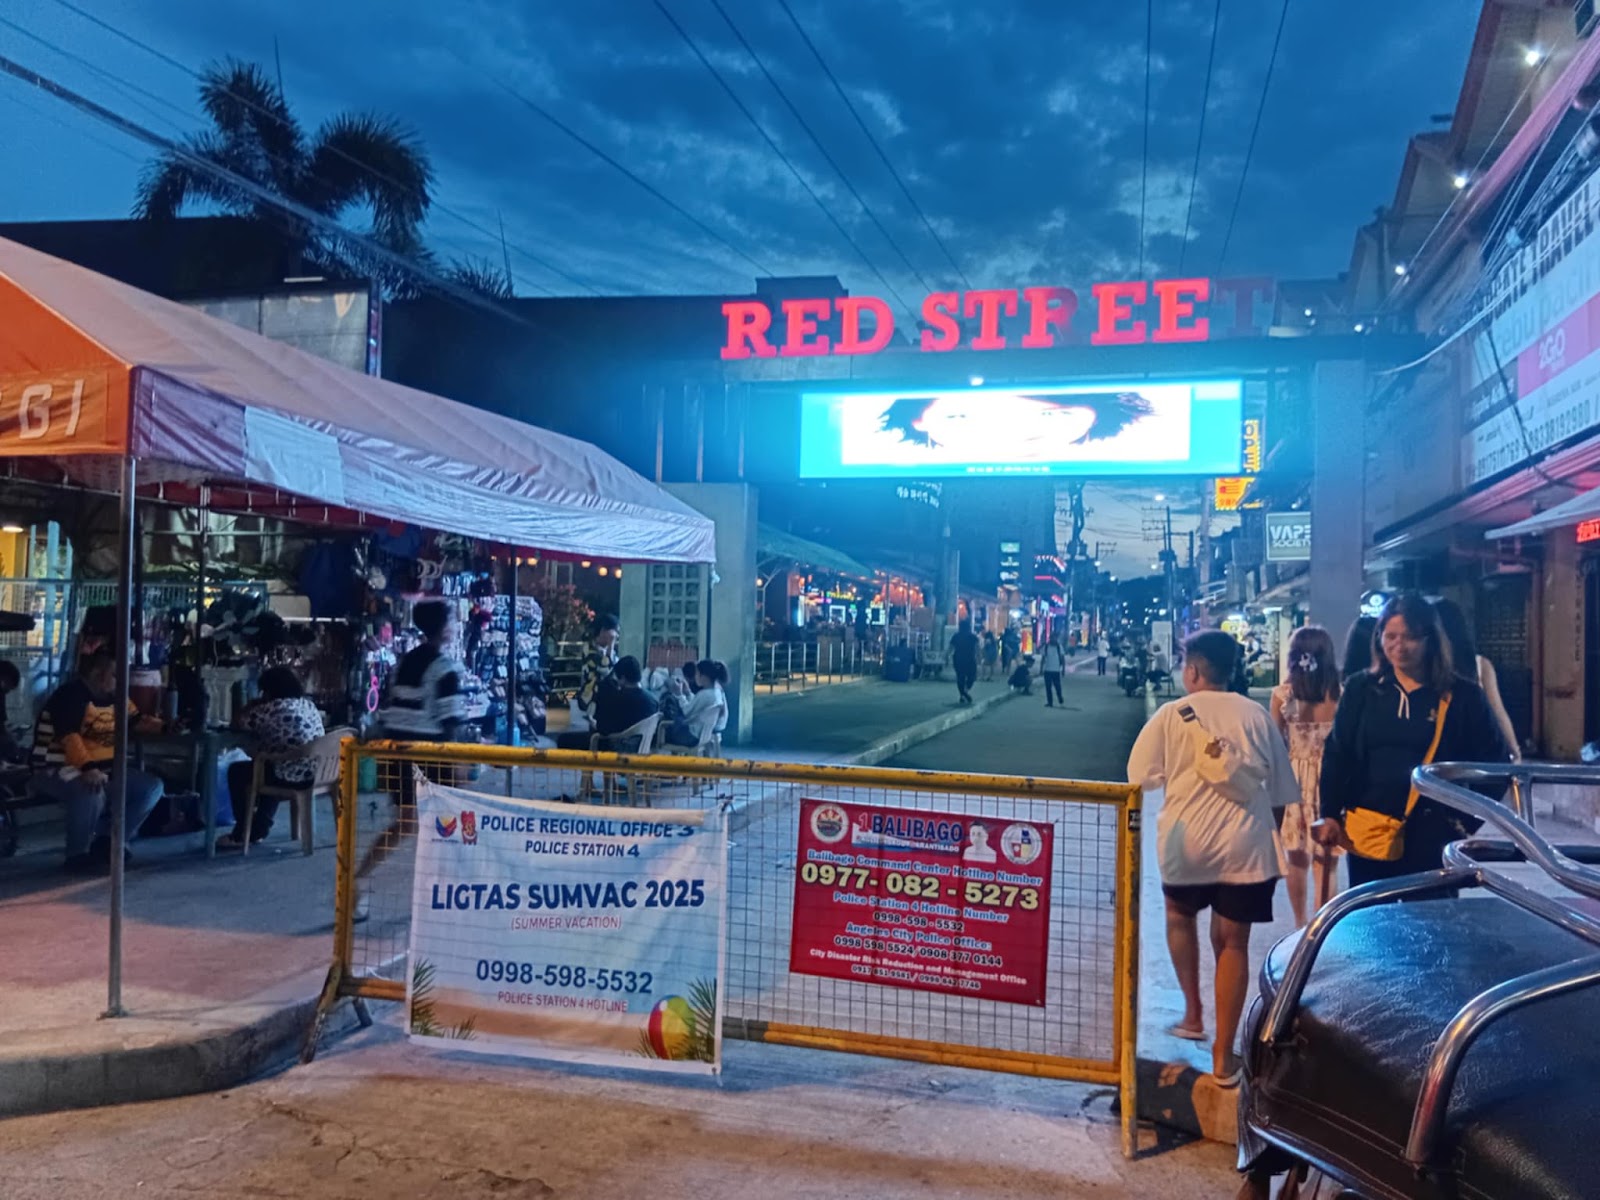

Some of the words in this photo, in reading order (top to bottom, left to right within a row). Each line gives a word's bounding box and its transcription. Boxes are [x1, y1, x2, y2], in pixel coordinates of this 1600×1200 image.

[721, 297, 895, 359] RED
[920, 279, 1270, 351] STREET
[0, 379, 85, 439] GI
[481, 815, 535, 833] POLICE
[539, 817, 615, 836] REGIONAL
[620, 821, 673, 838] OFFICE
[872, 814, 963, 842] BALIBAGO
[525, 840, 568, 856] POLICE
[573, 843, 624, 857] STATION
[627, 843, 640, 857] 4
[807, 849, 855, 865] Balibago
[857, 855, 911, 870] Command
[913, 861, 950, 875] Center
[953, 866, 995, 880] Hotline
[997, 871, 1043, 886] Number
[432, 884, 521, 910] LIGTAS
[528, 881, 637, 910] SUMVAC
[644, 879, 705, 908] 2025
[833, 891, 868, 904] Police
[869, 896, 909, 910] Station
[911, 902, 919, 911] 4
[921, 902, 960, 916] Hotline
[963, 907, 1009, 922] Number
[886, 872, 940, 898] 082
[965, 881, 1039, 910] 5273
[511, 916, 562, 930] (SUMMER
[565, 915, 622, 930] VACATION)
[845, 922, 890, 937] Angeles
[891, 929, 914, 941] City
[916, 931, 951, 945] Police
[874, 912, 900, 923] 0998
[935, 919, 964, 932] 5532
[810, 949, 826, 959] City
[882, 958, 924, 970] Reduction
[926, 964, 941, 973] and
[1000, 974, 1027, 985] Office
[834, 936, 861, 947] 0998
[864, 940, 884, 951] 598
[950, 951, 971, 962] 377
[973, 954, 1002, 967] 0144
[476, 959, 655, 994] 0998-598-5532
[498, 990, 533, 1006] POLICE
[536, 993, 577, 1009] STATION
[578, 996, 585, 1009] 4
[587, 997, 628, 1013] HOTLINE
